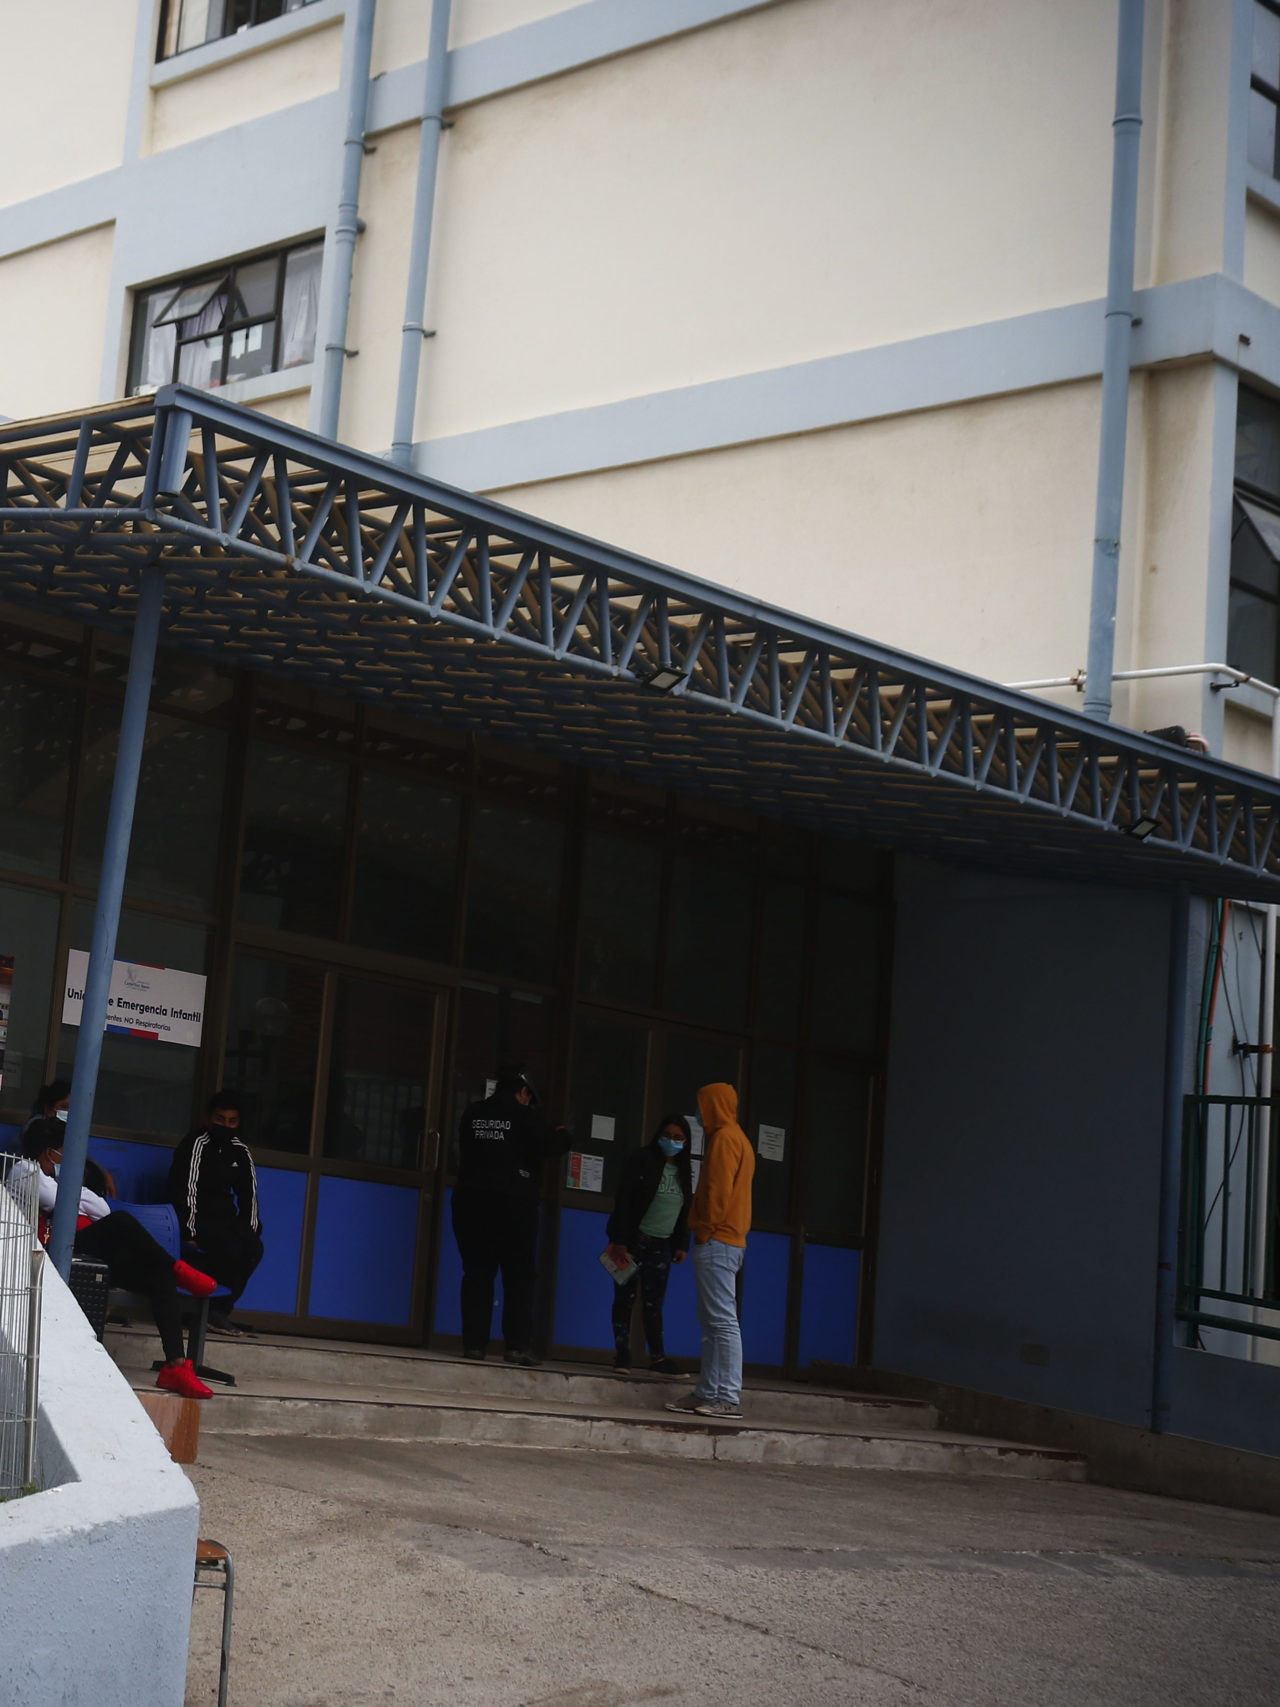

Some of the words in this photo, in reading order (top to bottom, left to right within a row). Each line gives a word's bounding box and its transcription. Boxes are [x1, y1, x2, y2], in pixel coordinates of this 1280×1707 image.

[67, 987, 86, 1001] Uni
[117, 997, 168, 1016] Emergencia
[170, 1007, 201, 1023] Infantil
[136, 1019, 171, 1032] Respiratorios
[472, 1119, 511, 1130] SEGURIDAD
[475, 1130, 505, 1141] PRIVADA
